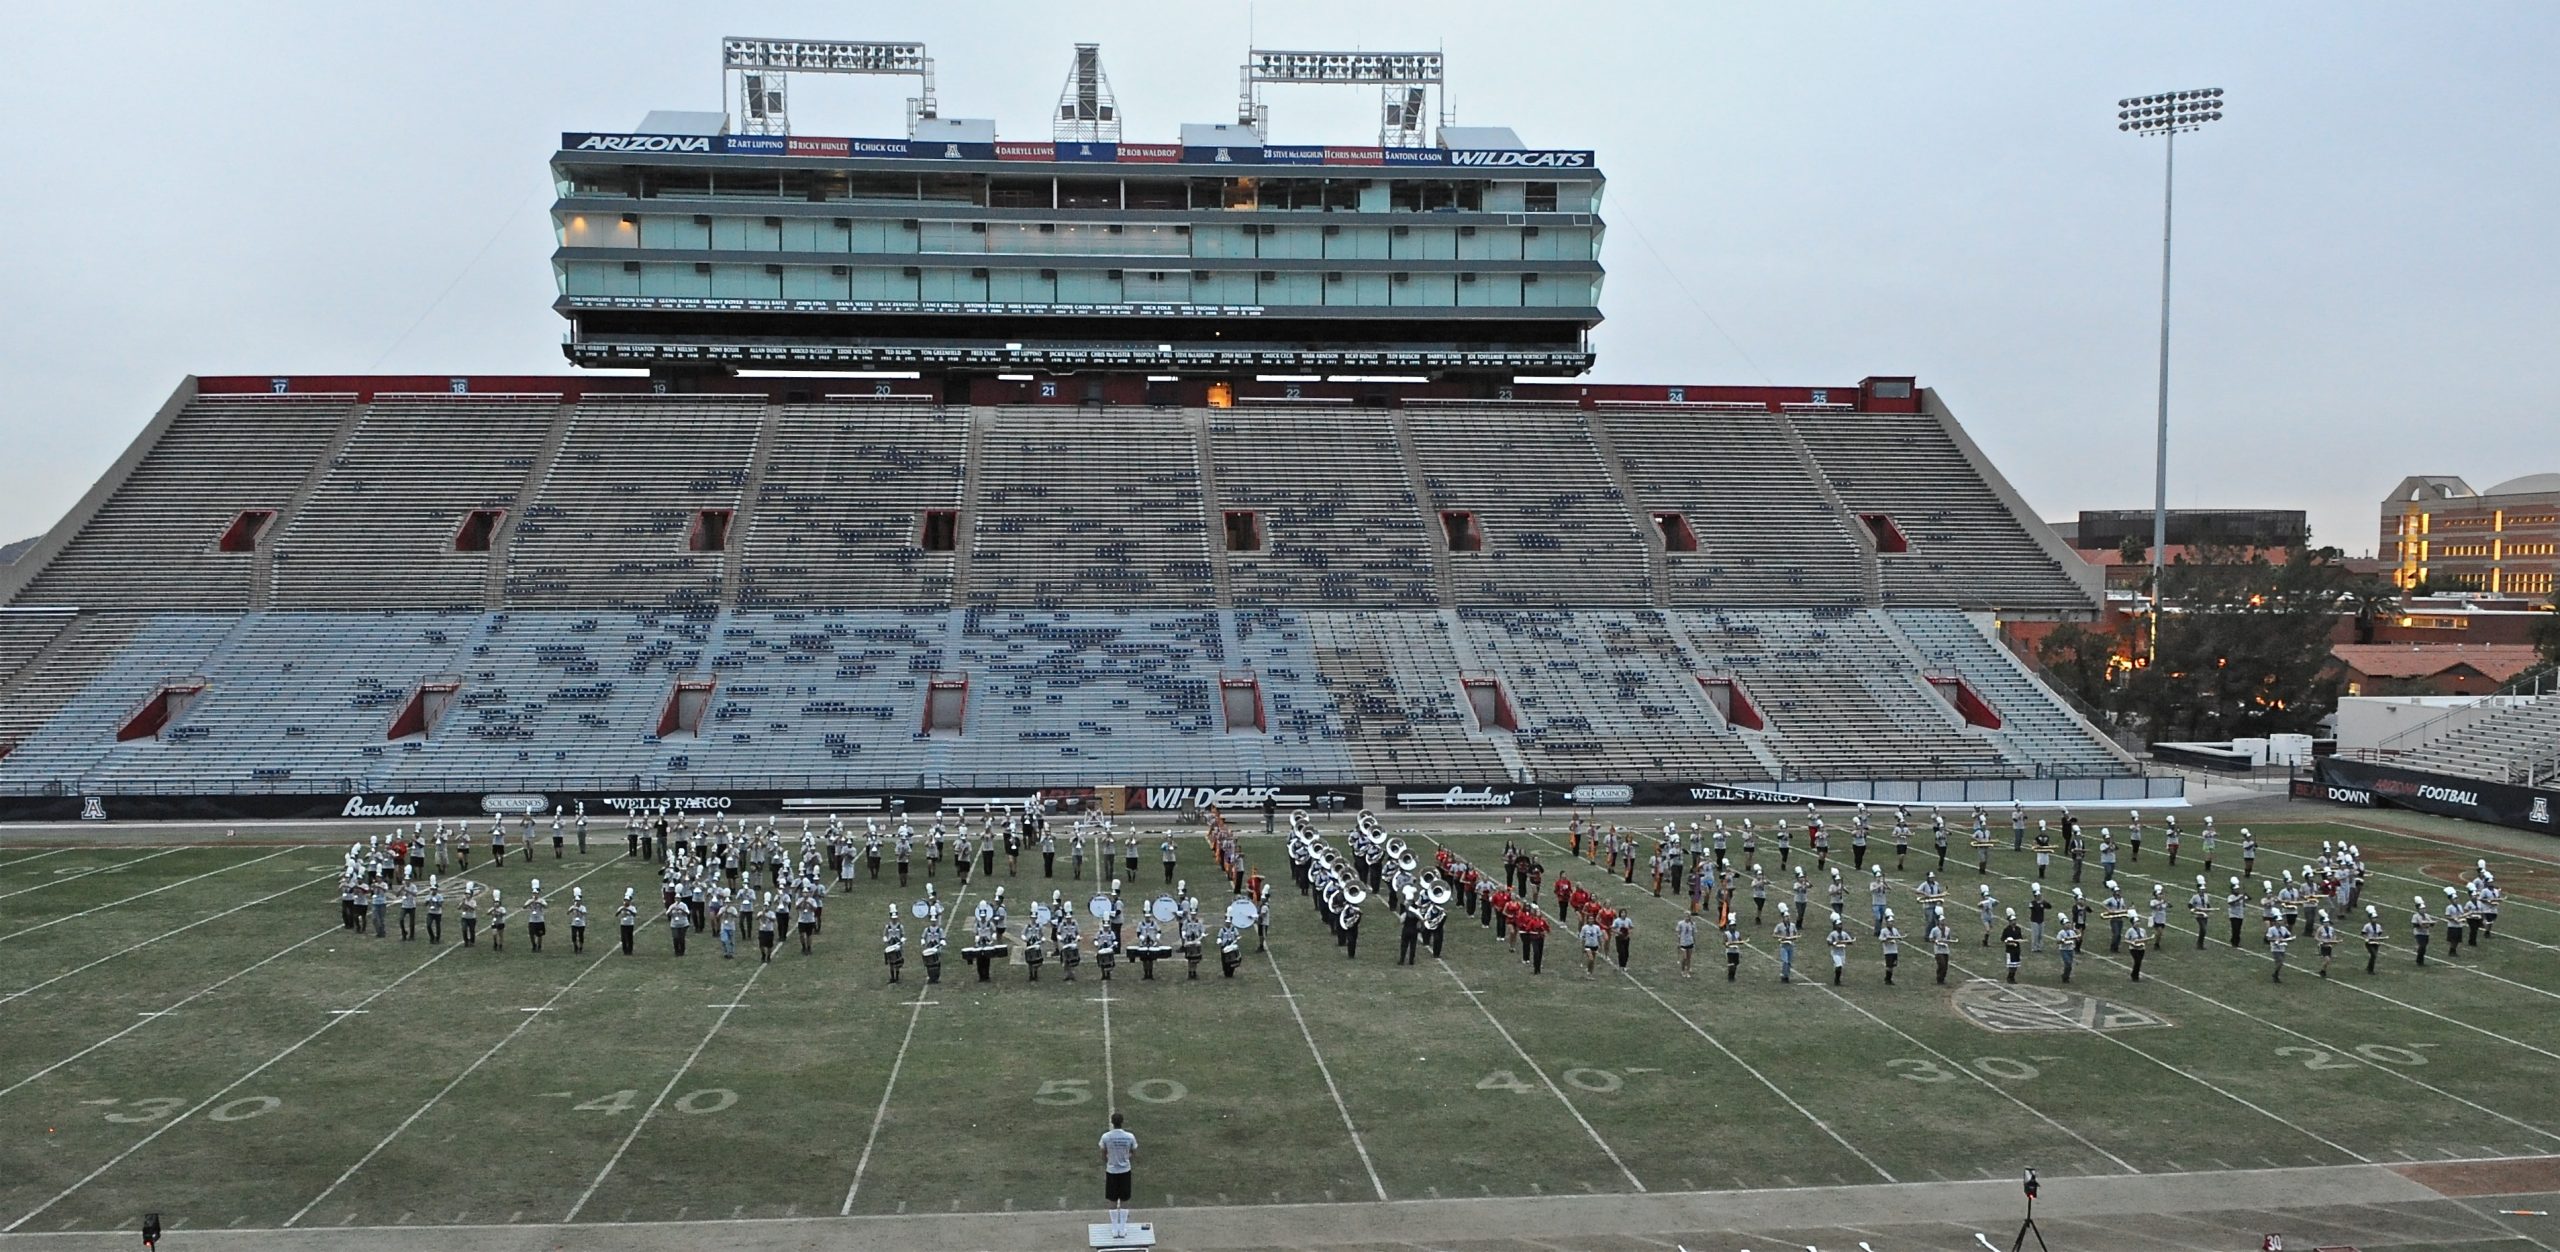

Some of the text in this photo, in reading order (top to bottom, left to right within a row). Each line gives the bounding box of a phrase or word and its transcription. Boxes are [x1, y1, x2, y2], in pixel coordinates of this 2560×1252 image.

[577, 136, 710, 151] ARIZONA
[728, 139, 784, 149] 22 ART LUPPINO
[798, 142, 820, 150] RICKY
[821, 142, 849, 151] HUNLEY
[887, 144, 908, 152] CECIL
[996, 146, 1000, 154] 4
[1142, 150, 1176, 158] WALDROP
[1324, 150, 1330, 159] 11
[1390, 152, 1418, 160] ANTOINE
[1419, 153, 1442, 161] CASON
[1451, 152, 1586, 166] WILDCATS
[272, 384, 286, 393] 17
[452, 384, 466, 393] 18
[653, 384, 666, 394] 19
[876, 386, 890, 395] 20
[1041, 386, 1056, 396] 21
[1286, 388, 1299, 398] 22
[1499, 391, 1512, 400] 23
[1670, 392, 1683, 402] 24
[1813, 394, 1826, 403] 25
[1690, 788, 1744, 800] WELLS
[2296, 784, 2370, 804] BEAR DOWN
[2417, 784, 2478, 806] FOOTBALL
[342, 796, 418, 816] Bashas'
[611, 796, 732, 809] WELLS FARGO
[82, 797, 107, 820] A
[2530, 797, 2550, 824] A
[2274, 1043, 2429, 1070] 20
[1885, 1056, 2040, 1082] 30
[1474, 1067, 1624, 1094] 40
[1032, 1077, 1188, 1106] 50
[572, 1088, 738, 1116] 40
[105, 1096, 282, 1122] 30
[2266, 1234, 2282, 1251] 30
